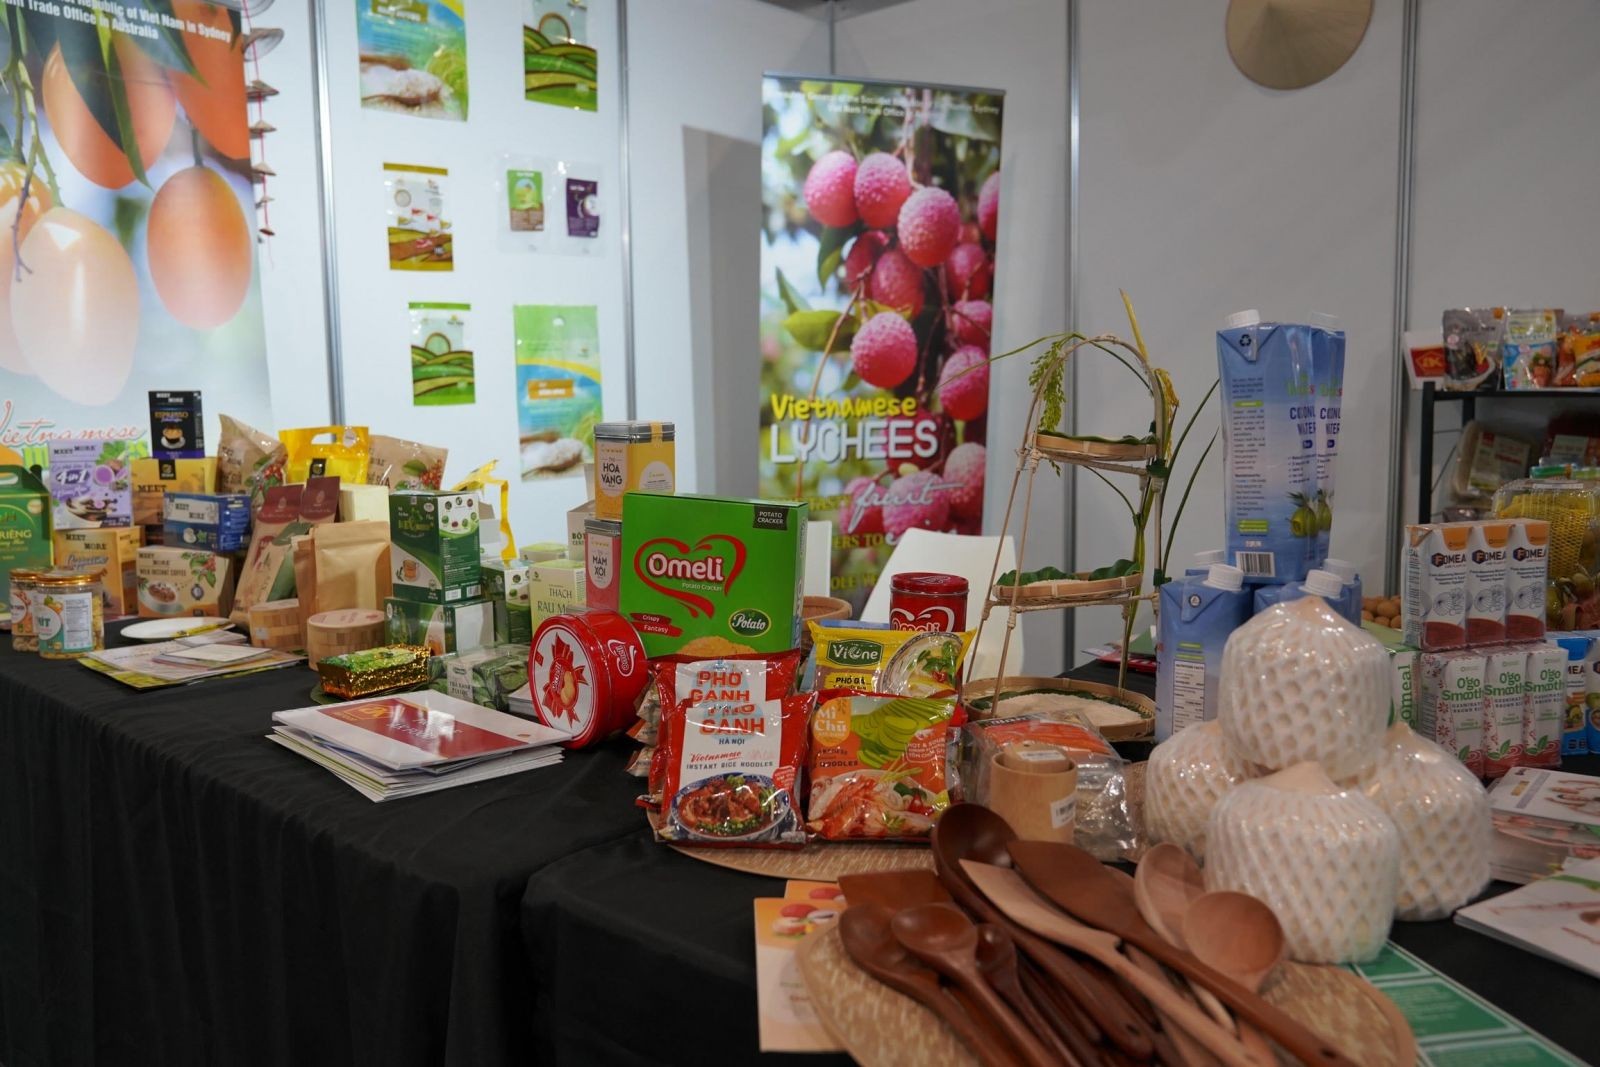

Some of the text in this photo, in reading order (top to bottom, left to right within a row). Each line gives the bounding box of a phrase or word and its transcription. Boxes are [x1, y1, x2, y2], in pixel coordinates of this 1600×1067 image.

[28, 0, 158, 39] Trade Office in Australia
[127, 7, 137, 19] of
[139, 9, 160, 24] Viet
[161, 14, 185, 30] Nam
[187, 20, 196, 33] in
[198, 23, 231, 43] Sydney
[771, 394, 917, 421] Vietnamese
[770, 419, 938, 463] LYCHEES
[603, 462, 620, 473] HOA
[759, 511, 783, 519] POTATO
[847, 482, 965, 534] fruit
[757, 517, 784, 525] CRACKER
[832, 534, 859, 549] ERS
[1432, 552, 1466, 567] FOMEA
[1472, 550, 1506, 564] FOMEA
[170, 569, 187, 577] COFFEE
[648, 552, 724, 582] Omeli
[682, 582, 723, 592] Potato Cracker
[831, 576, 856, 590] OLE
[537, 601, 555, 613] RAU
[732, 613, 766, 630] Potato
[891, 618, 940, 632] Omeli
[644, 624, 669, 634] Fantasy
[1457, 669, 1561, 690] O'go O'go O'go
[1524, 680, 1565, 693] Smooth
[1397, 664, 1412, 720] omeal
[690, 751, 742, 762] Vietnamese
